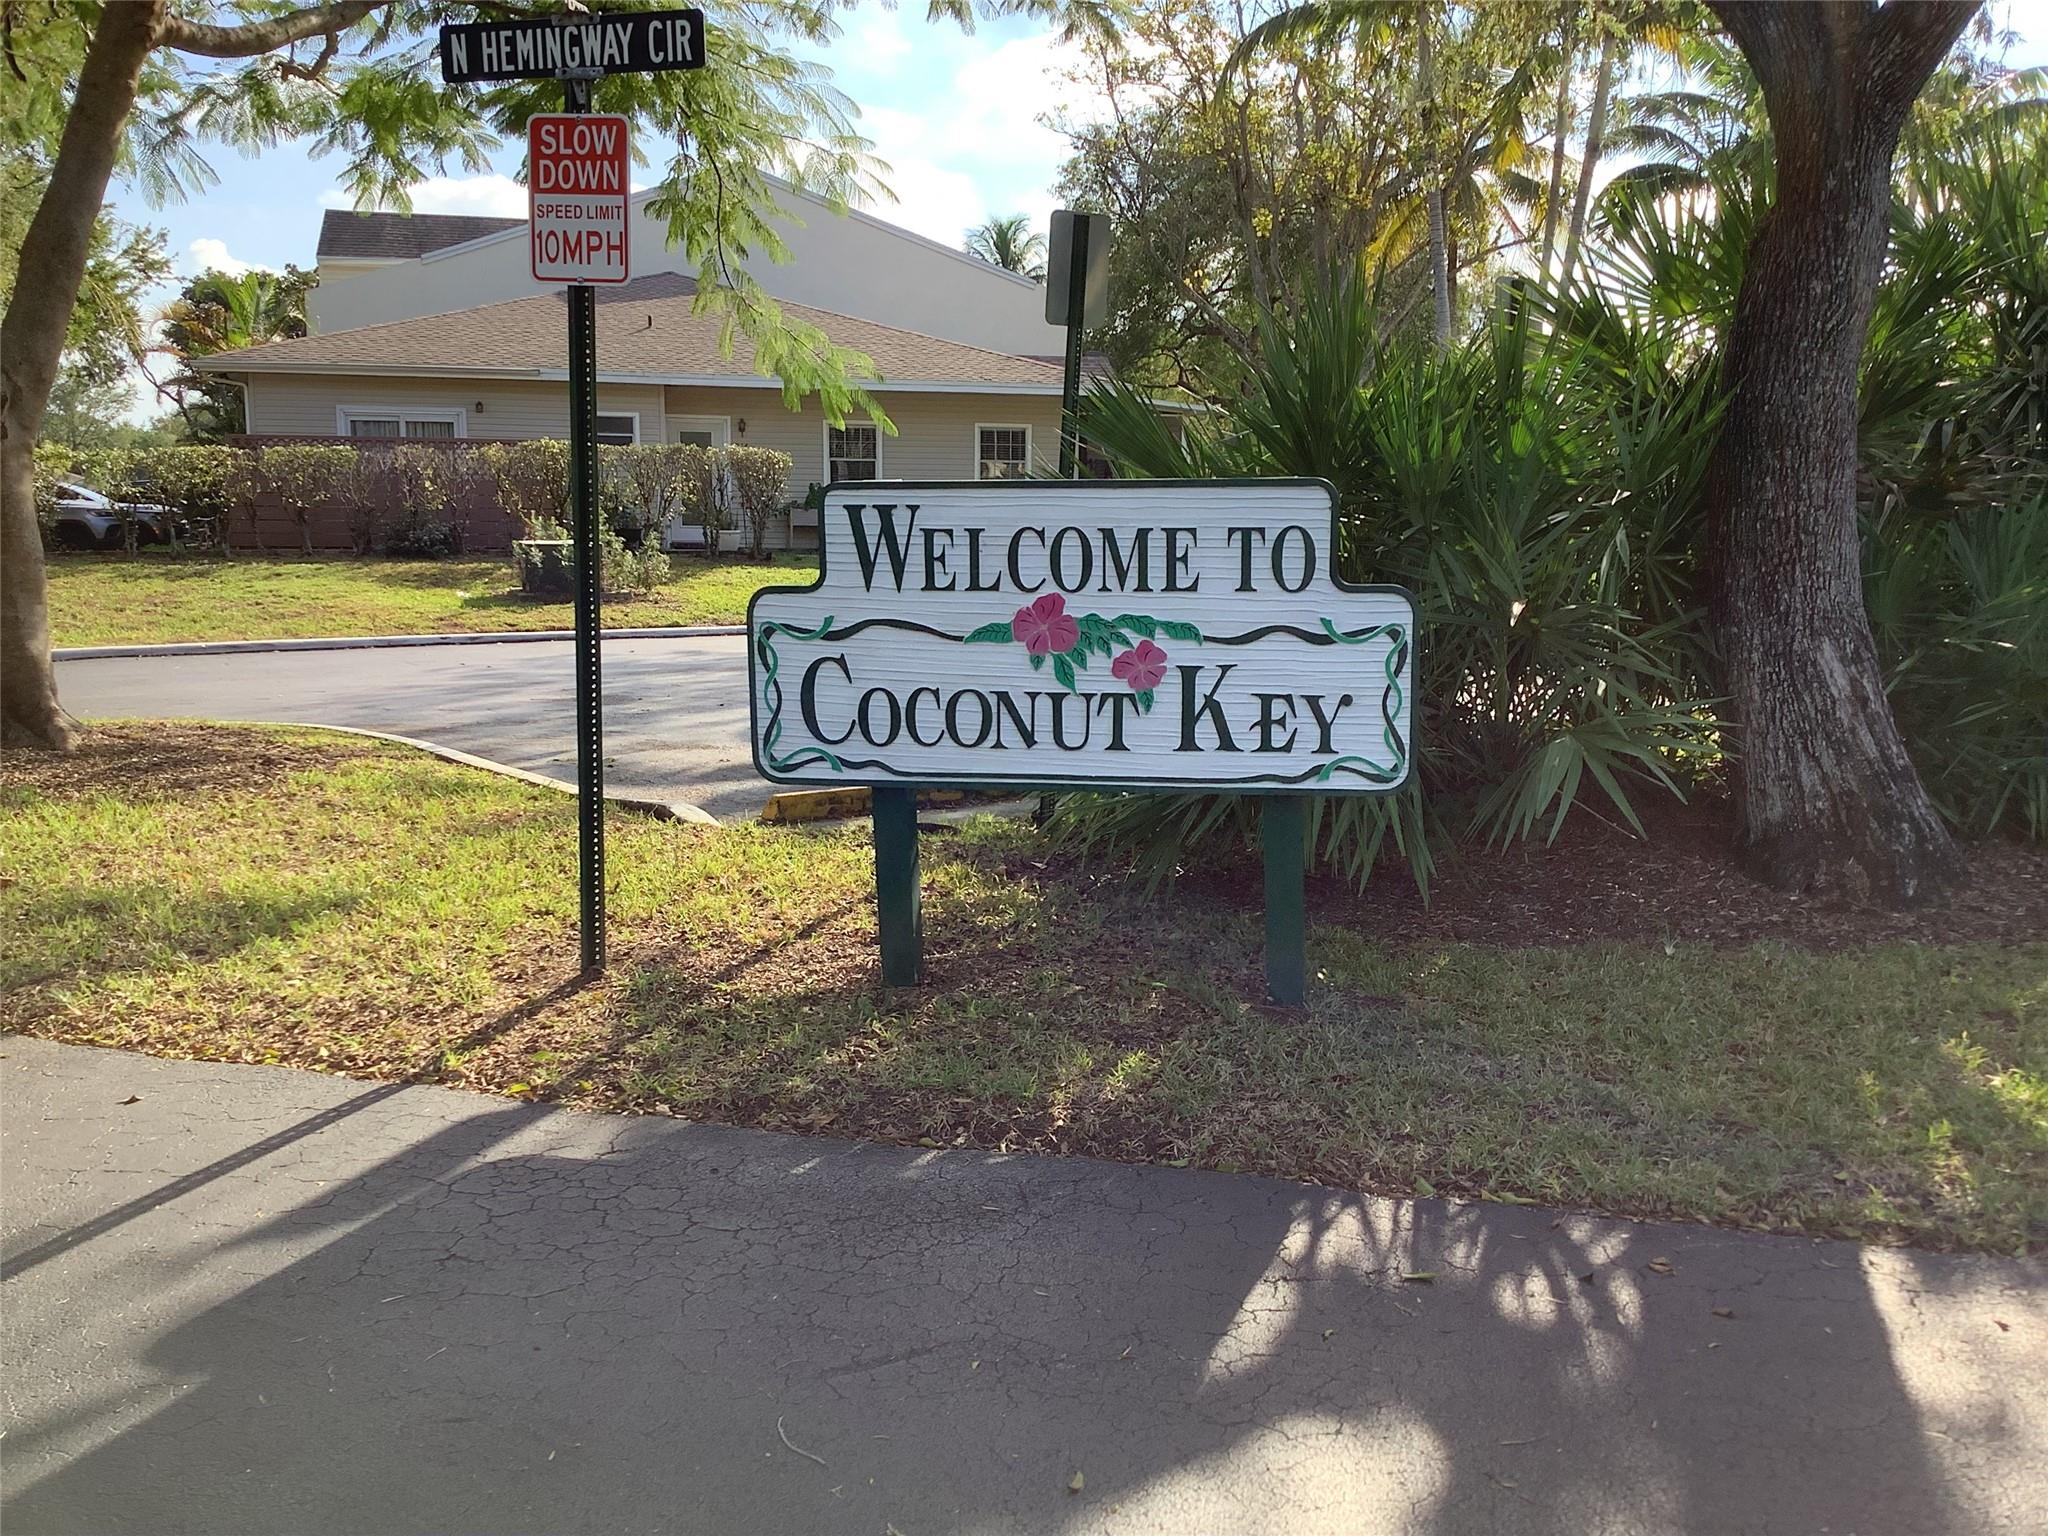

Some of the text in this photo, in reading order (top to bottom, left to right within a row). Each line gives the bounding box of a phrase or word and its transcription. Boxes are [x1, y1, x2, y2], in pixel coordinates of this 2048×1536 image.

[450, 19, 692, 75] N HEMINGWAY CIR
[540, 124, 617, 155] SLOW
[539, 160, 619, 190] DOWN
[536, 204, 623, 221] SPEED LIMIT
[536, 230, 624, 266] 10MPH
[843, 504, 1317, 593] WELCOME TO
[799, 653, 1354, 754] COCONUT KEY
